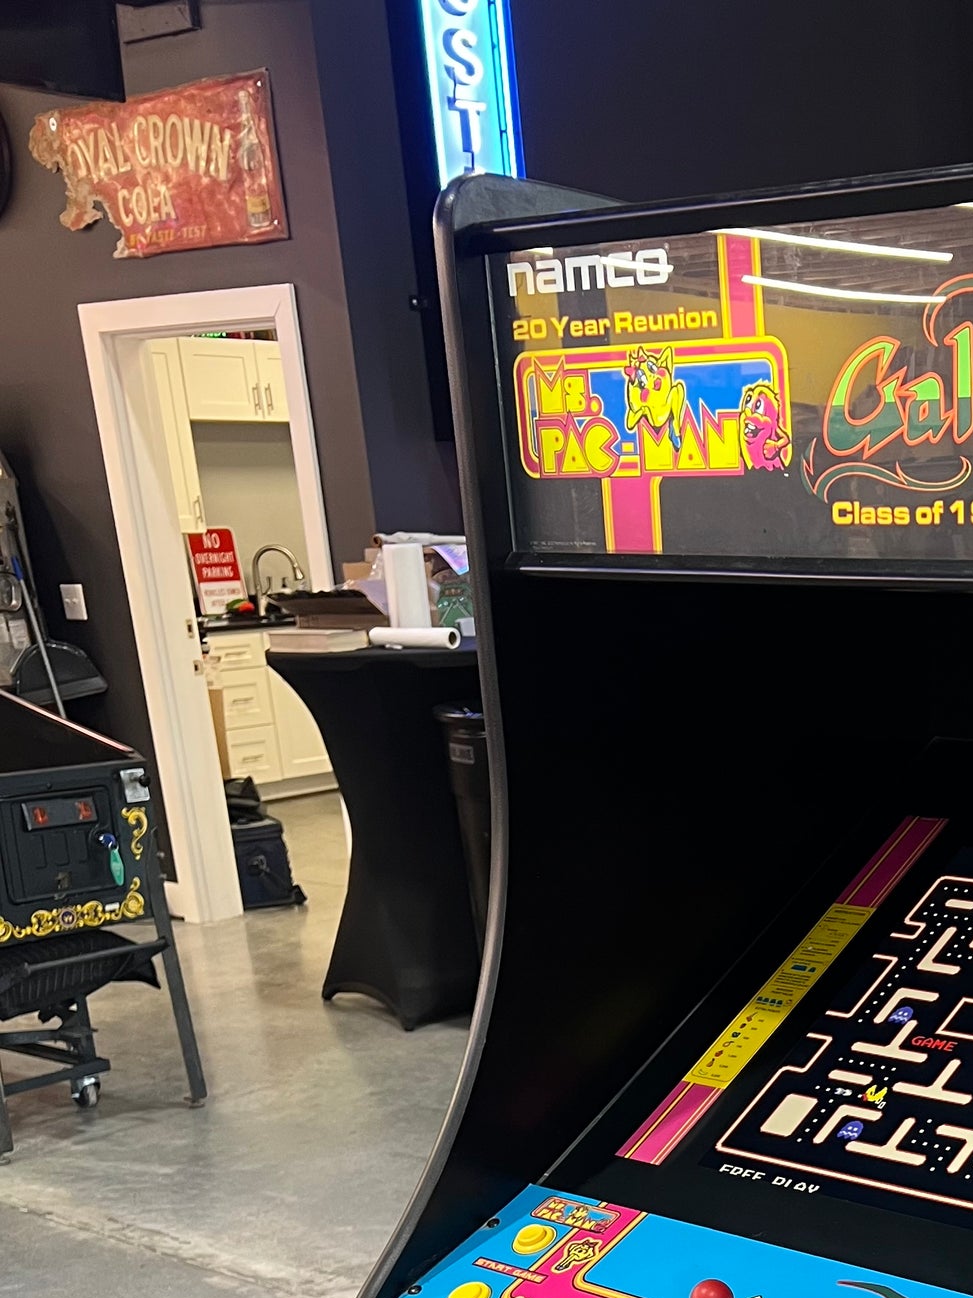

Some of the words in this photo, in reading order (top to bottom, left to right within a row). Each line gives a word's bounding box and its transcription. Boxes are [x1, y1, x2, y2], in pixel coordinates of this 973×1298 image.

[66, 121, 132, 184] OYAL
[133, 113, 233, 181] CROWN
[117, 183, 177, 226] COLA
[507, 248, 669, 297] namco
[512, 318, 547, 341] 20
[550, 315, 611, 338] Year
[614, 306, 718, 335] Reunion
[831, 501, 911, 525] Class
[915, 501, 945, 525] of
[203, 533, 220, 549] NO
[201, 565, 234, 579] PARKING
[911, 1036, 958, 1051] GAME
[474, 1258, 512, 1274] START
